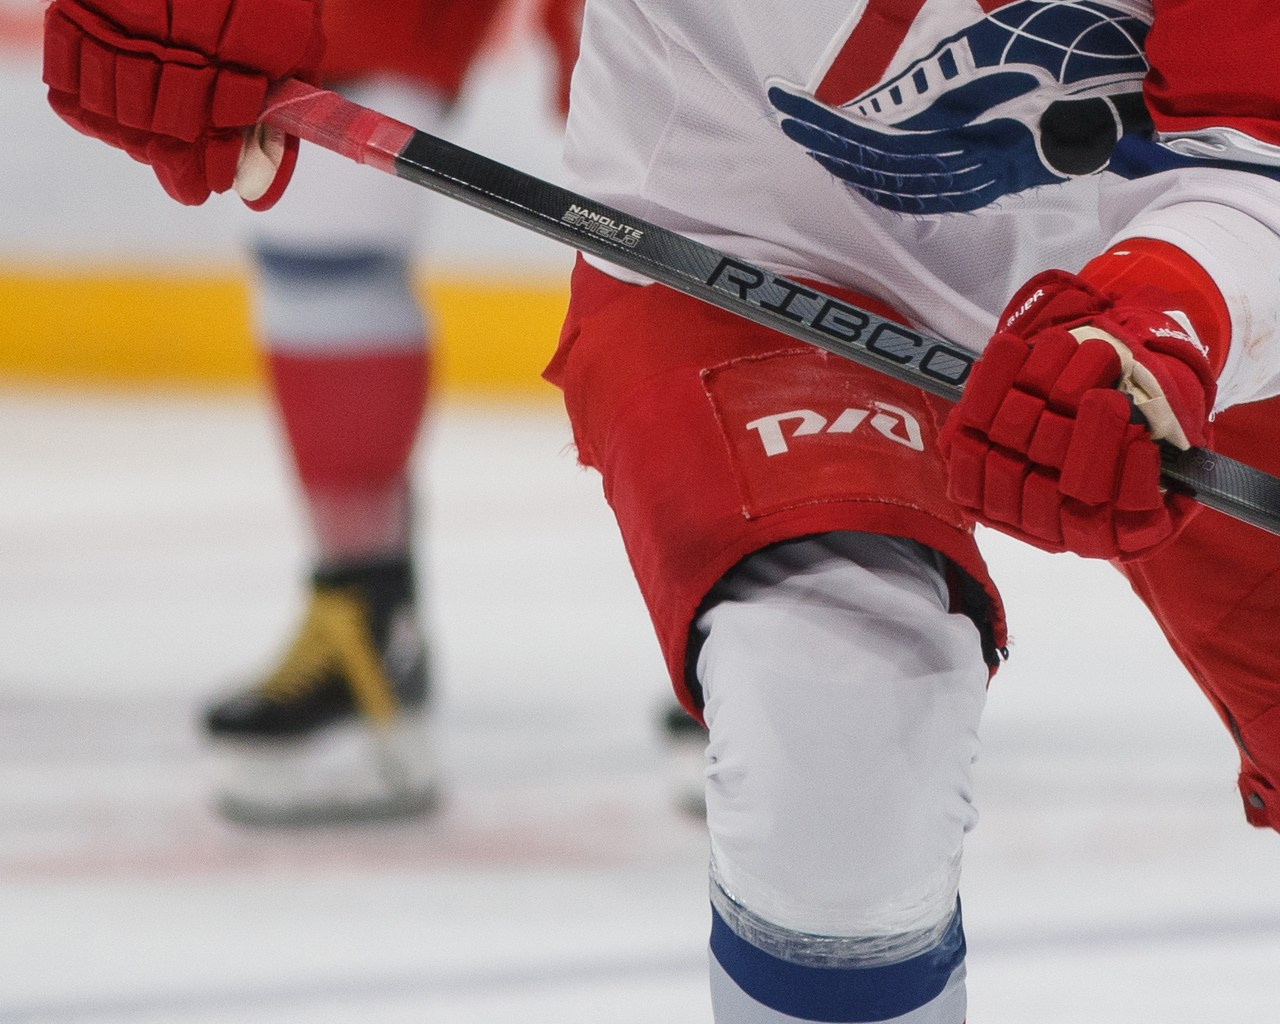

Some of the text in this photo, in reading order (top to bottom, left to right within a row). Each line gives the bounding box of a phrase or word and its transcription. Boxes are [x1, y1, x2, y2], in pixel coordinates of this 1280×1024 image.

[562, 210, 639, 248] SHIELD
[569, 204, 644, 238] NANOLITE
[706, 256, 975, 386] RIBCO
